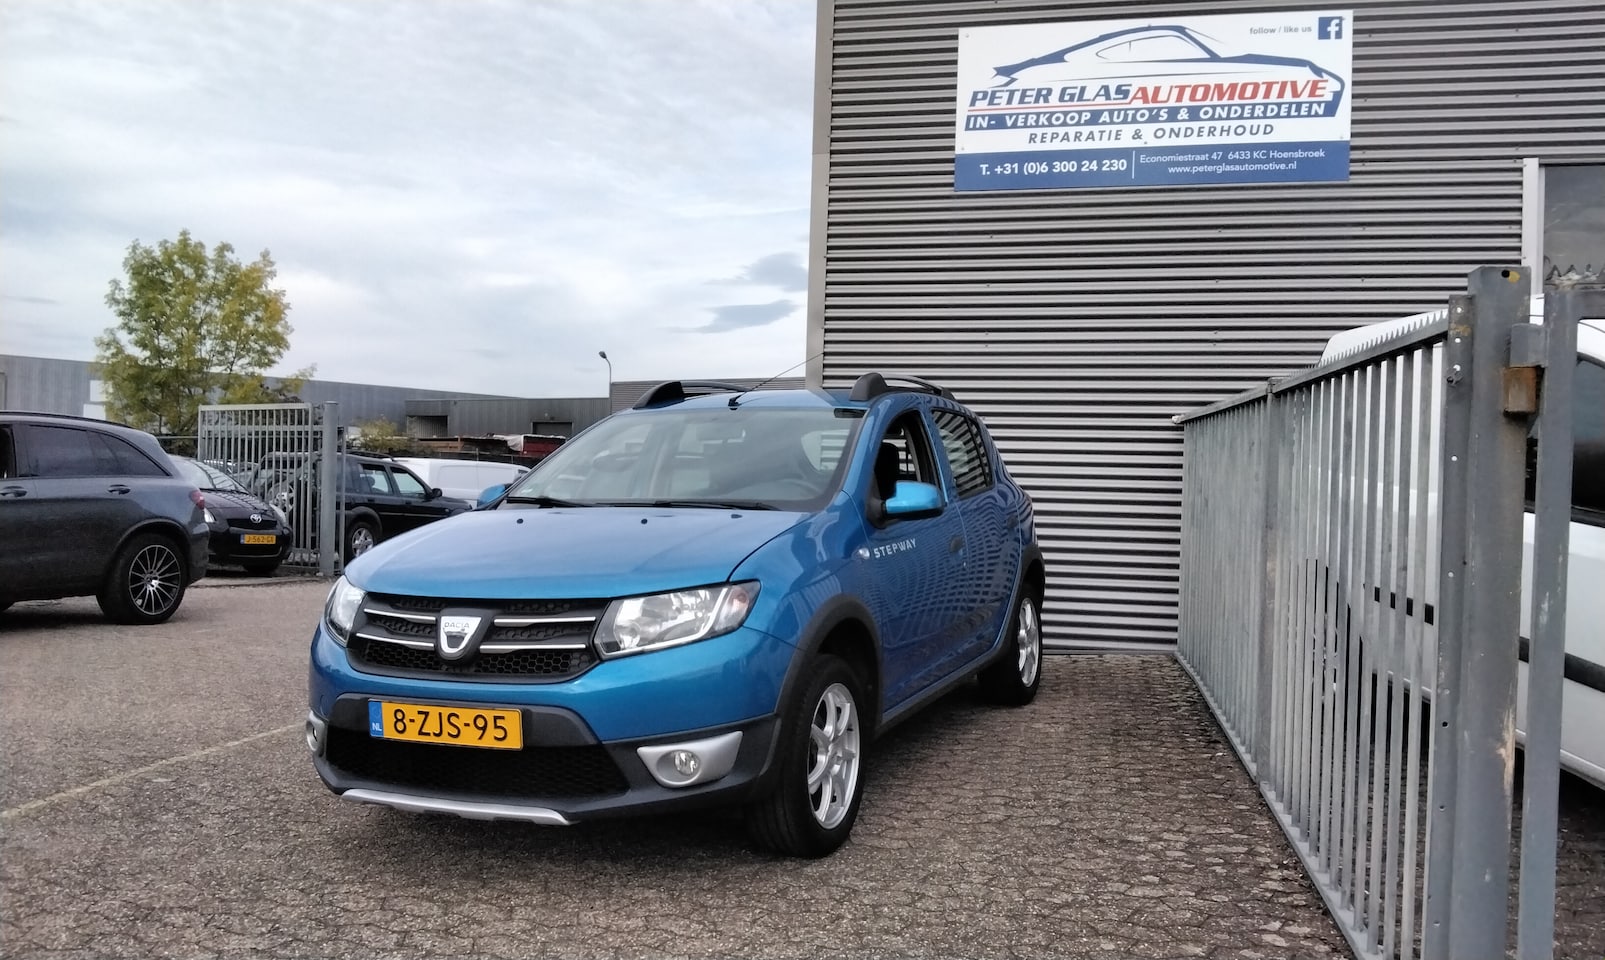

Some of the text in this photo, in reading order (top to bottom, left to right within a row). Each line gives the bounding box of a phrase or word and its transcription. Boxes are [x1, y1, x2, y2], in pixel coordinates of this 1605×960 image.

[1249, 27, 1276, 35] follow
[968, 87, 1053, 107] PETER
[968, 103, 1326, 129] IN- VERKOOP AUTO'S & ONDERDELEN
[1028, 124, 1274, 144] REPARATIE & ONDERHOUD
[1140, 148, 1325, 163] Economiestraat 47 6433 KC Hoensbroek
[979, 159, 1127, 175] T. +31 (0)6 300 24 230
[1168, 161, 1297, 174] www.peterglasautomotive.nl
[873, 538, 917, 559] STEPWAY
[444, 621, 470, 629] DACIA
[371, 708, 508, 742] NL 8-ZJS-95
